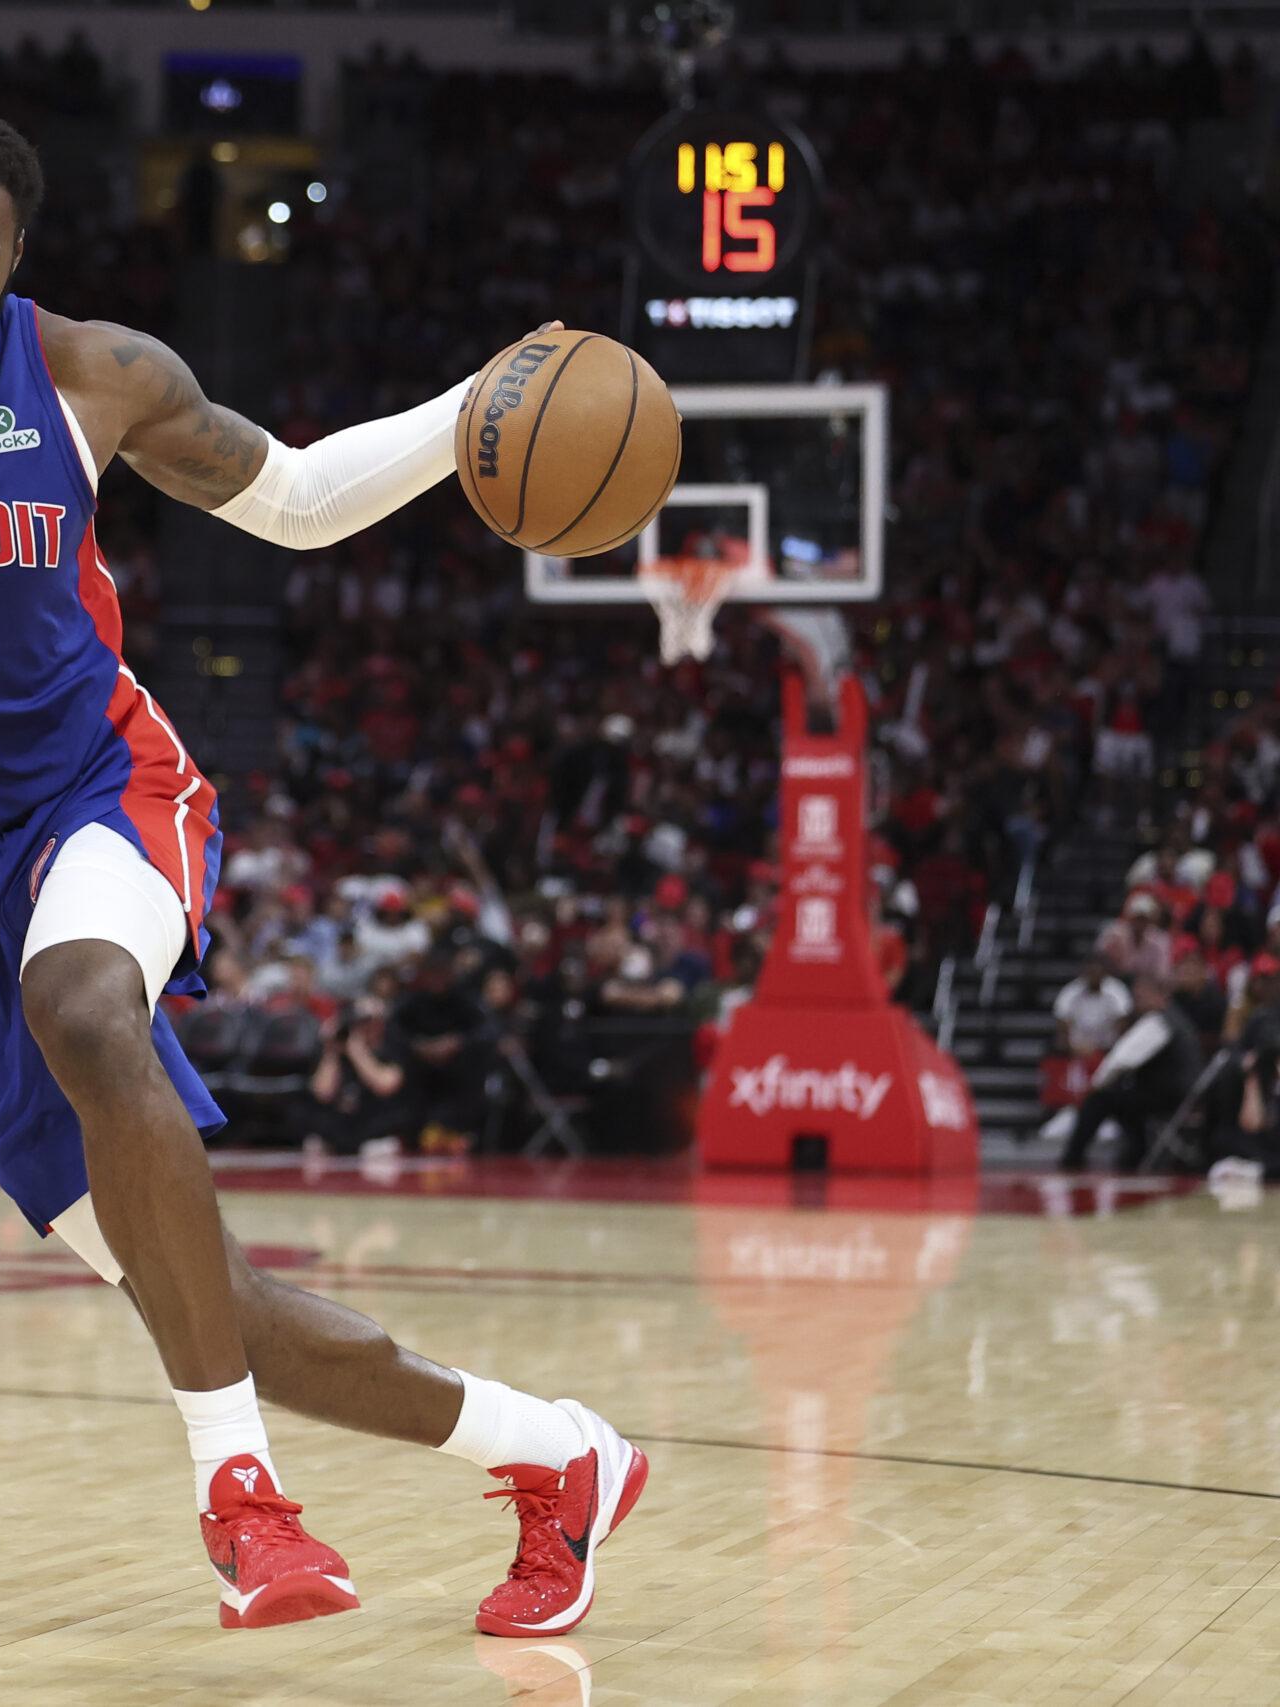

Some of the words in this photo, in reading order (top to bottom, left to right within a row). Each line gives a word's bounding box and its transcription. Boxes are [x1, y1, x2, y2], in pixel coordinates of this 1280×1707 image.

[702, 187, 776, 272] 15
[477, 343, 561, 478] Wilson
[728, 1054, 892, 1120] xfinity
